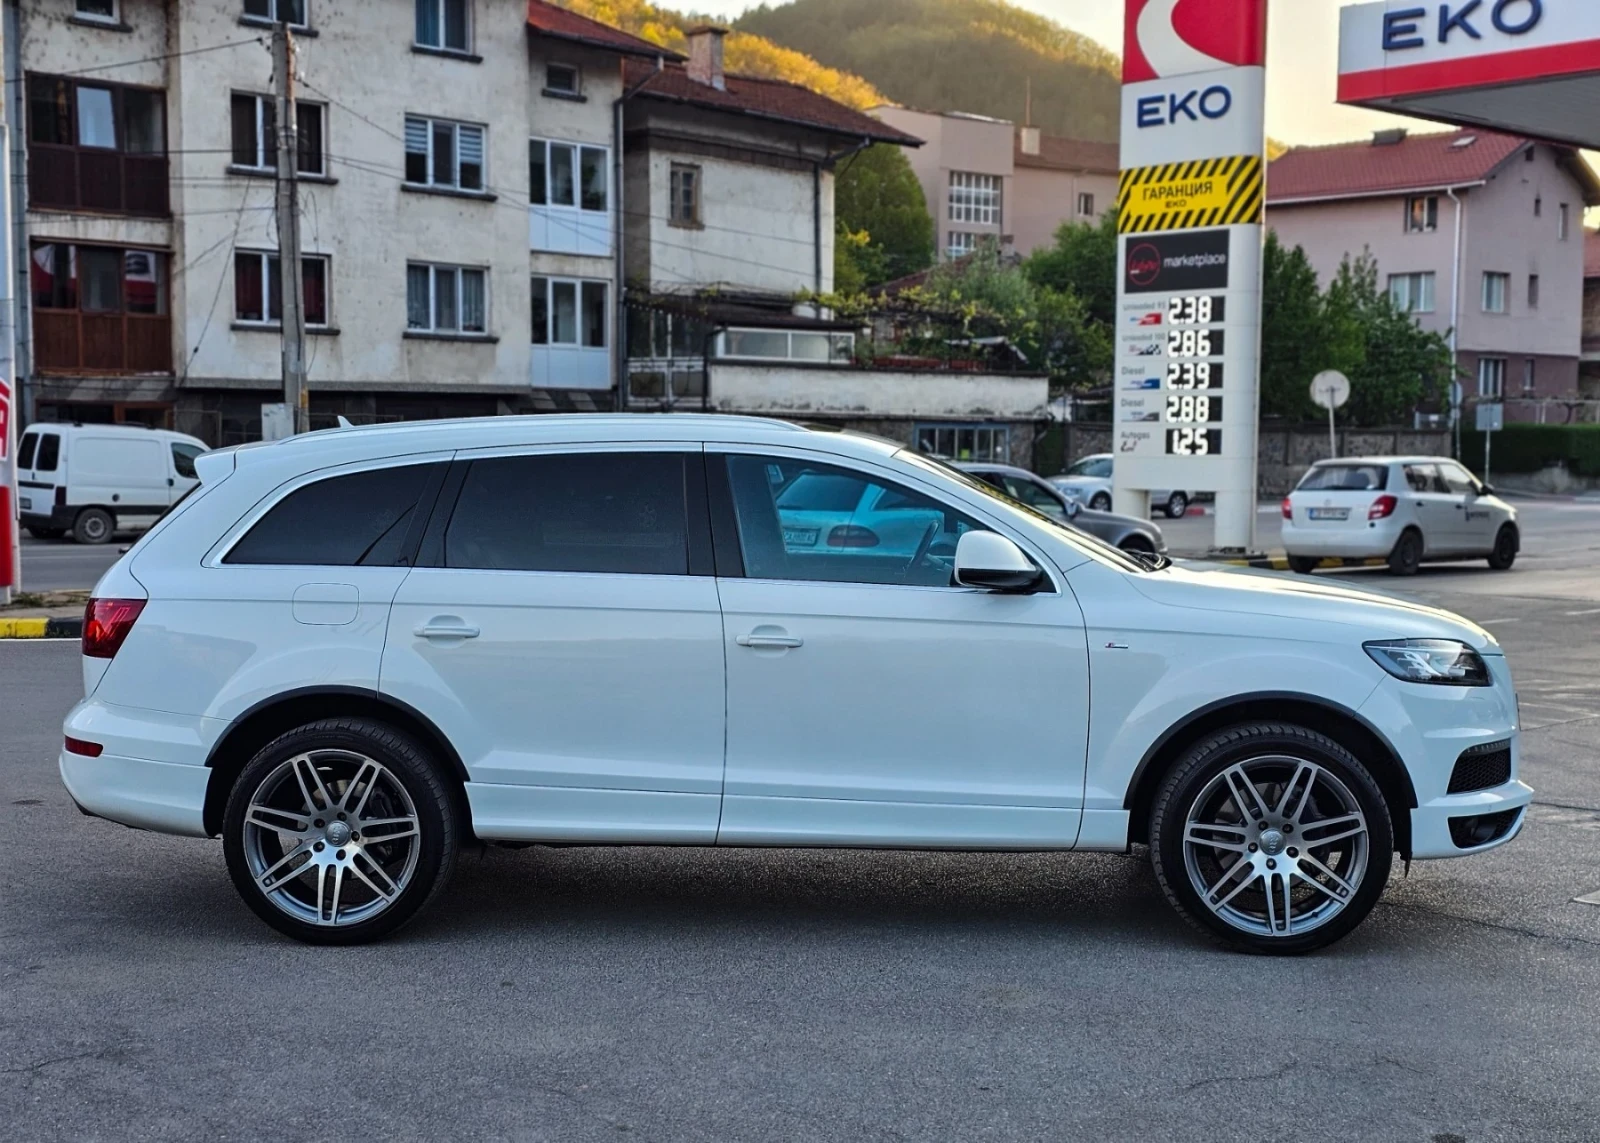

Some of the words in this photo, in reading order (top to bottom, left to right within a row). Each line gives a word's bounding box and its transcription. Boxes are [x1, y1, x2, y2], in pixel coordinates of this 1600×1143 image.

[1382, 0, 1543, 51] EKO
[1137, 85, 1232, 128] EKO
[1142, 181, 1213, 200] ГАРАНЦИЯ
[1163, 252, 1226, 268] marketplace
[1168, 296, 1212, 325] 2.38
[1167, 329, 1211, 358] 2.86
[1121, 366, 1145, 375] Diesel
[1167, 362, 1210, 390] 2.39
[1121, 398, 1144, 407] Diesel
[1166, 395, 1209, 423] 2.88
[1120, 431, 1151, 441] Autogas
